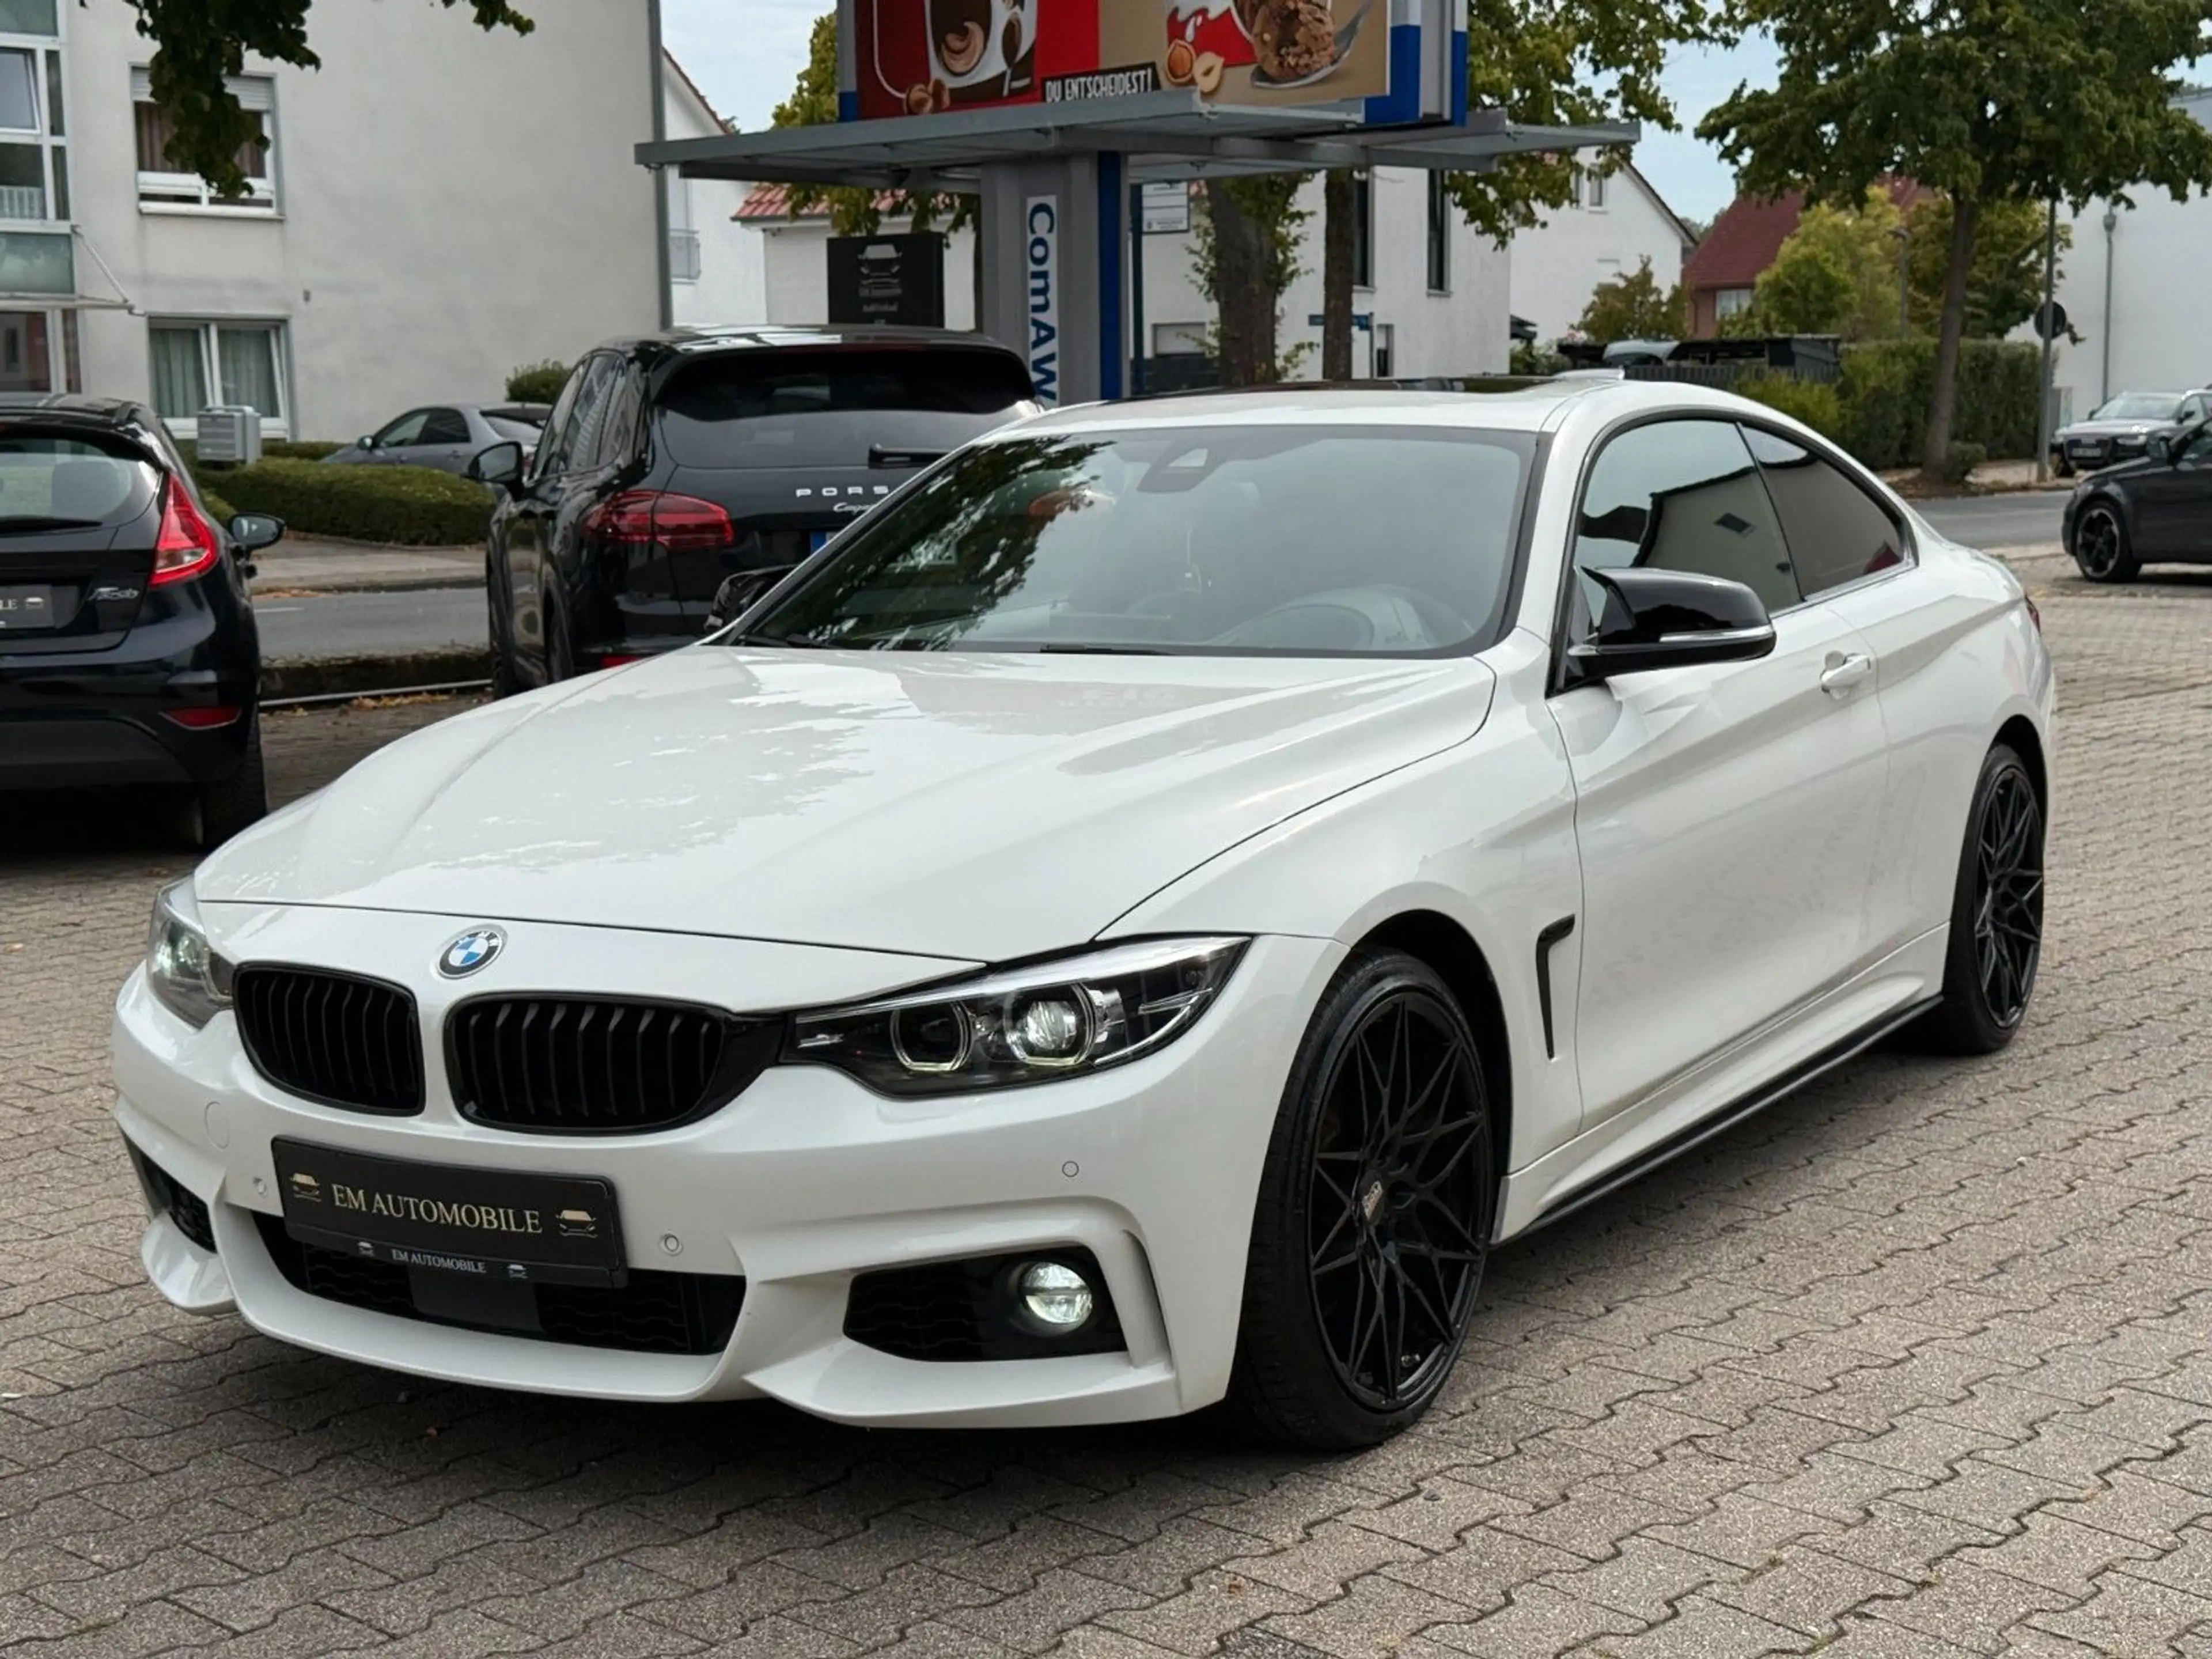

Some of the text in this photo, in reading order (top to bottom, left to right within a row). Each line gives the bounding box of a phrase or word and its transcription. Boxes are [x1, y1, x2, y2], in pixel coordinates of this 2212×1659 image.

[1046, 79, 1062, 103] DU
[796, 486, 889, 497] PORS
[331, 1183, 543, 1234] EM AUTOMOBILE
[411, 1252, 487, 1273] AUTOMOBILE
